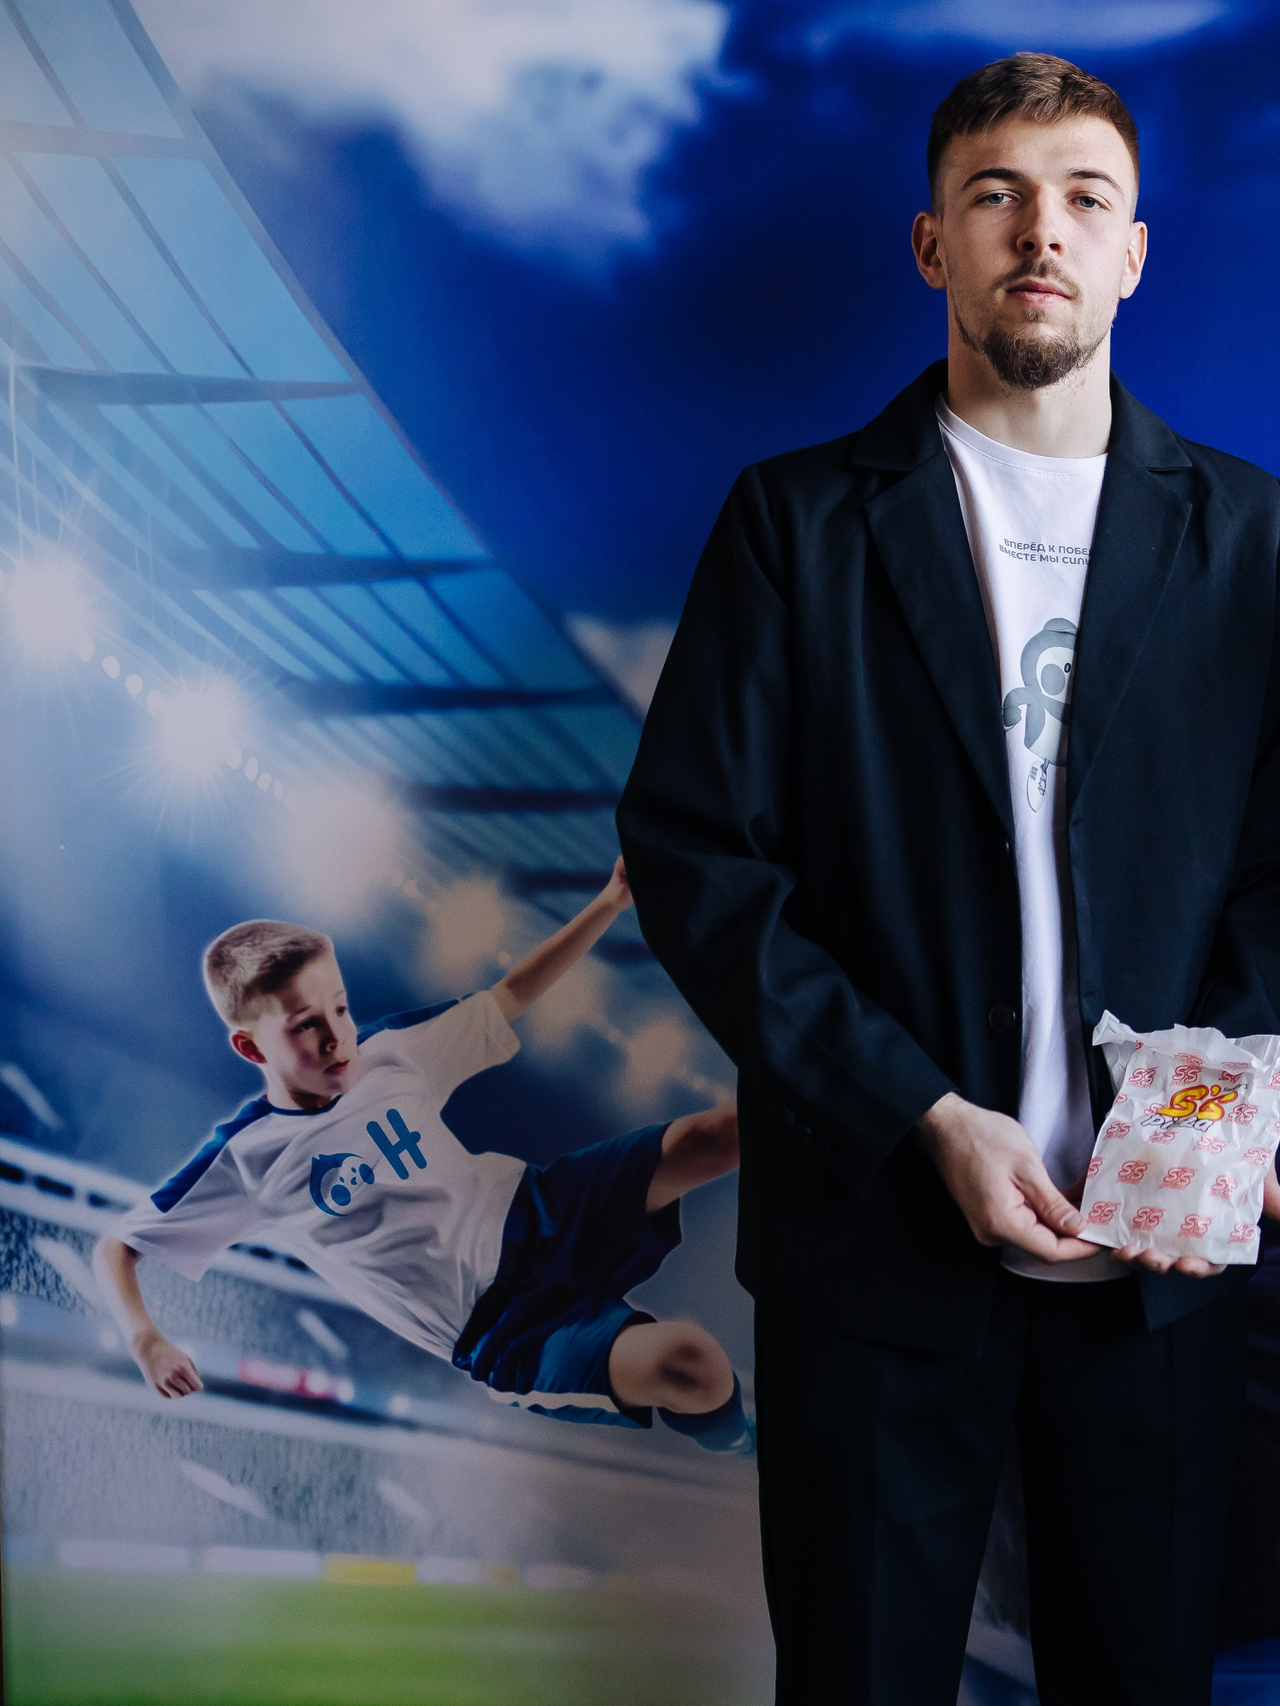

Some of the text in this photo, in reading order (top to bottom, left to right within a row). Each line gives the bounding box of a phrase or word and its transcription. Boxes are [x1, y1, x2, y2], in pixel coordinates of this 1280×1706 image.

[999, 544, 1036, 561] ВМЕСТЕ
[1040, 554, 1059, 563] МЫ
[1004, 538, 1091, 556] ВПЕРЁД К ПОБЕ
